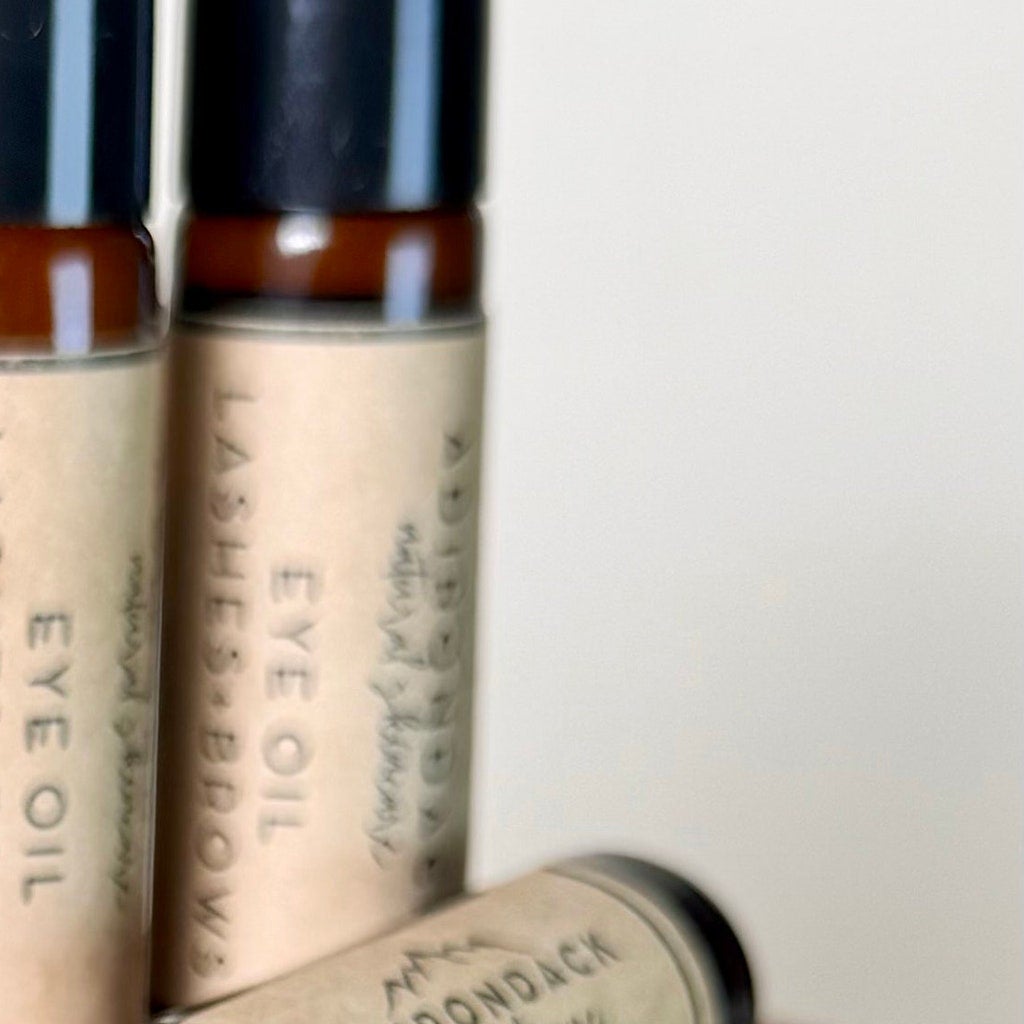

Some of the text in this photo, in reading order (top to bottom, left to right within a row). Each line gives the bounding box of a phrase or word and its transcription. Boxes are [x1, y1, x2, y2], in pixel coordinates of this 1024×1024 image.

[17, 608, 73, 905] EYE OIL
[259, 562, 322, 846] EYE OIL
